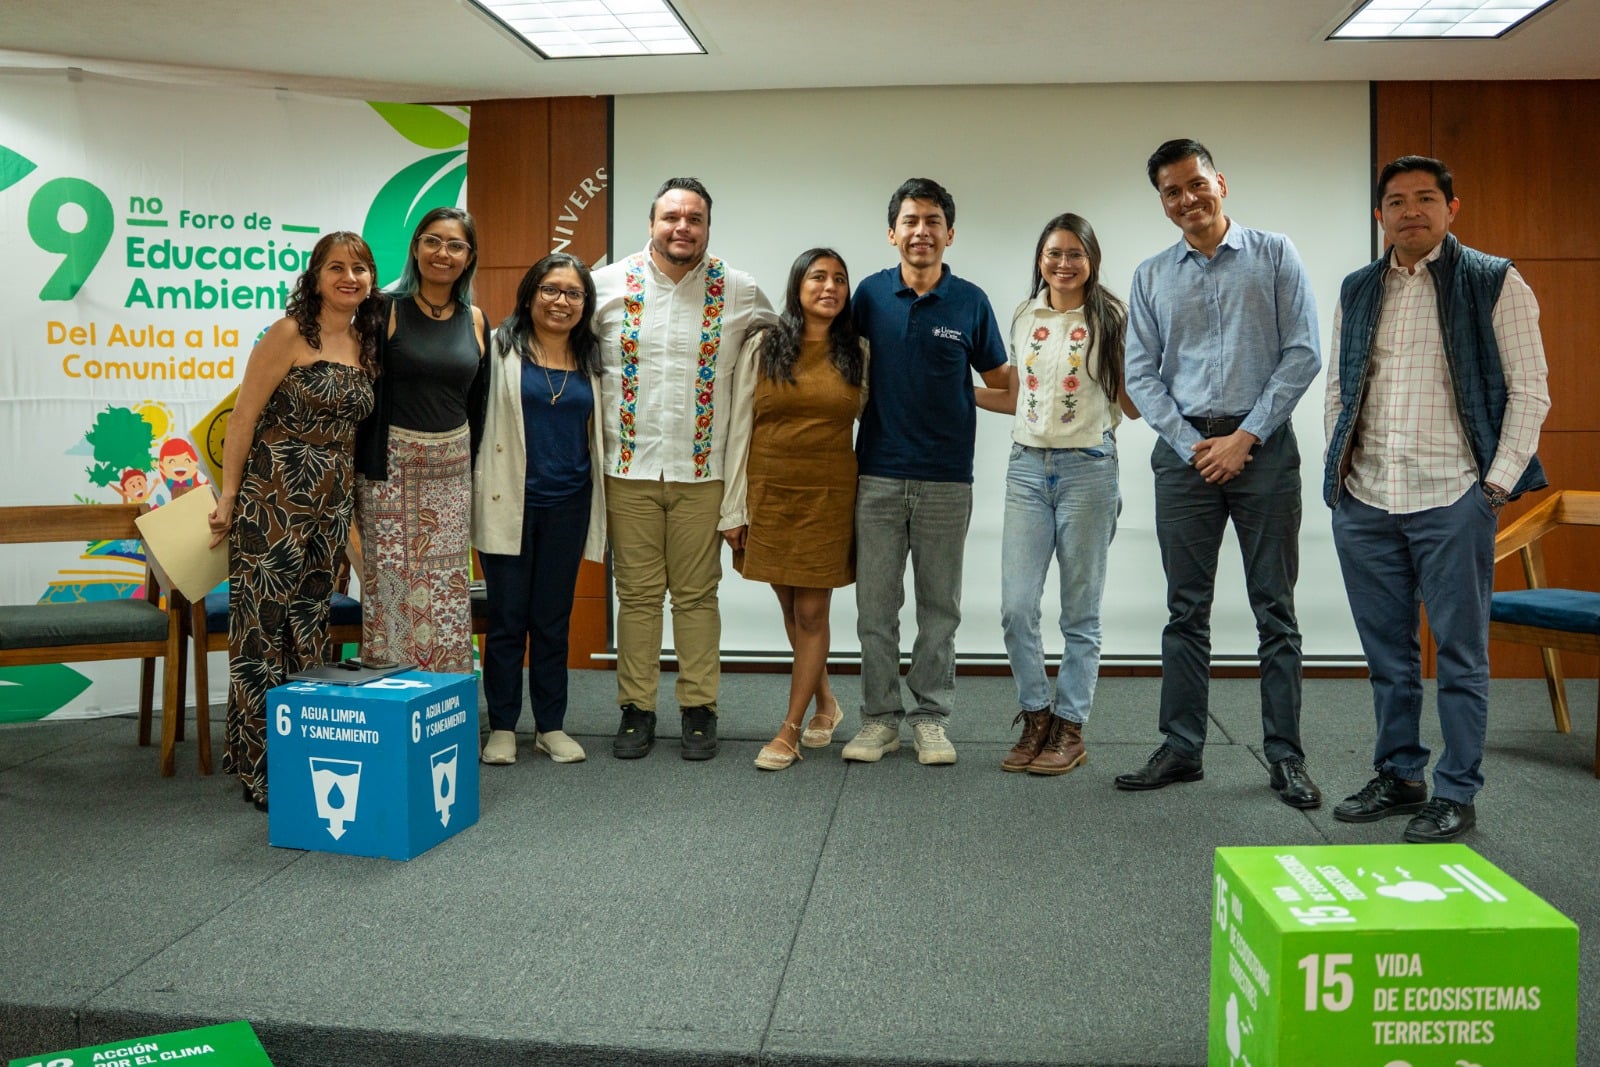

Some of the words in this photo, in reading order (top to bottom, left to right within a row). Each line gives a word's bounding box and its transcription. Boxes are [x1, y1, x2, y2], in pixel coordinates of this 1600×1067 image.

[179, 210, 235, 230] Foro
[243, 212, 272, 231] de
[550, 167, 608, 256] NIVERS
[27, 177, 115, 301] 9
[129, 196, 163, 215] no
[124, 278, 295, 310] Ambient
[47, 321, 96, 346] Del
[107, 324, 175, 348] Aula
[184, 330, 203, 348] a
[213, 324, 239, 348] la
[62, 354, 235, 381] Comunidad
[275, 704, 292, 736] 6
[301, 706, 329, 722] AGUA
[331, 708, 367, 724] LIMPIA
[425, 702, 441, 720] AGUA
[441, 695, 460, 713] LIMPIA
[300, 725, 308, 738] Y
[309, 726, 380, 745] SANEAMIENTO
[411, 710, 422, 744] 6
[425, 724, 430, 738] Y
[1216, 873, 1229, 932] 15
[1375, 953, 1423, 977] VIDA
[1298, 953, 1355, 1012] 15
[1374, 988, 1399, 1012] DE
[1404, 986, 1541, 1011] ECOSISTEMAS
[1372, 1021, 1495, 1045] TERRESTRES
[92, 1042, 159, 1062] ACCIÓN
[135, 1055, 157, 1065] EL
[159, 1044, 215, 1060] CLIMA
